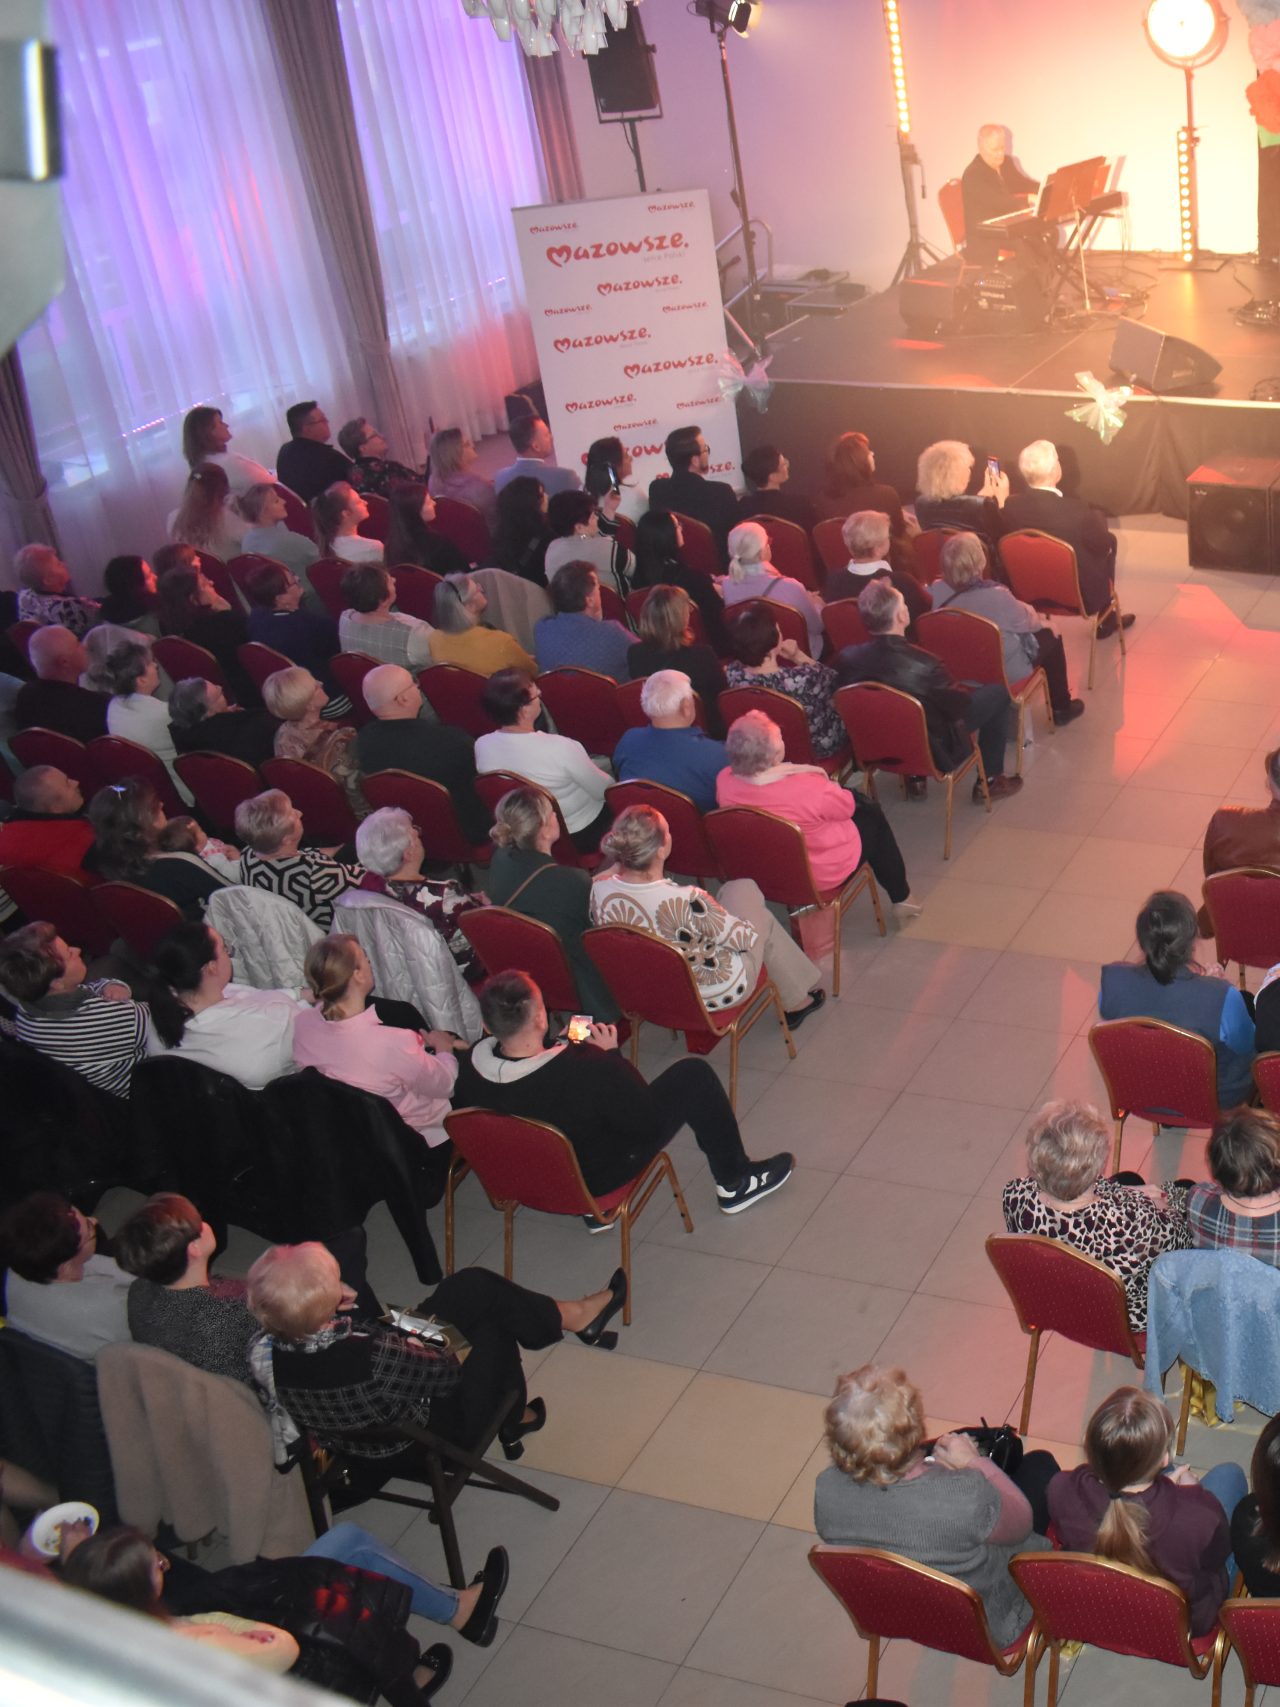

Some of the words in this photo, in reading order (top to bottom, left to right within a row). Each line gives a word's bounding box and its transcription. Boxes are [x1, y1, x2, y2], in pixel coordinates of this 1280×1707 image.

[546, 232, 689, 268] Mazowsze.
[597, 274, 682, 296] Mazowsze.
[553, 327, 652, 354] Mazowsze.
[623, 352, 718, 379] Mazowsze.
